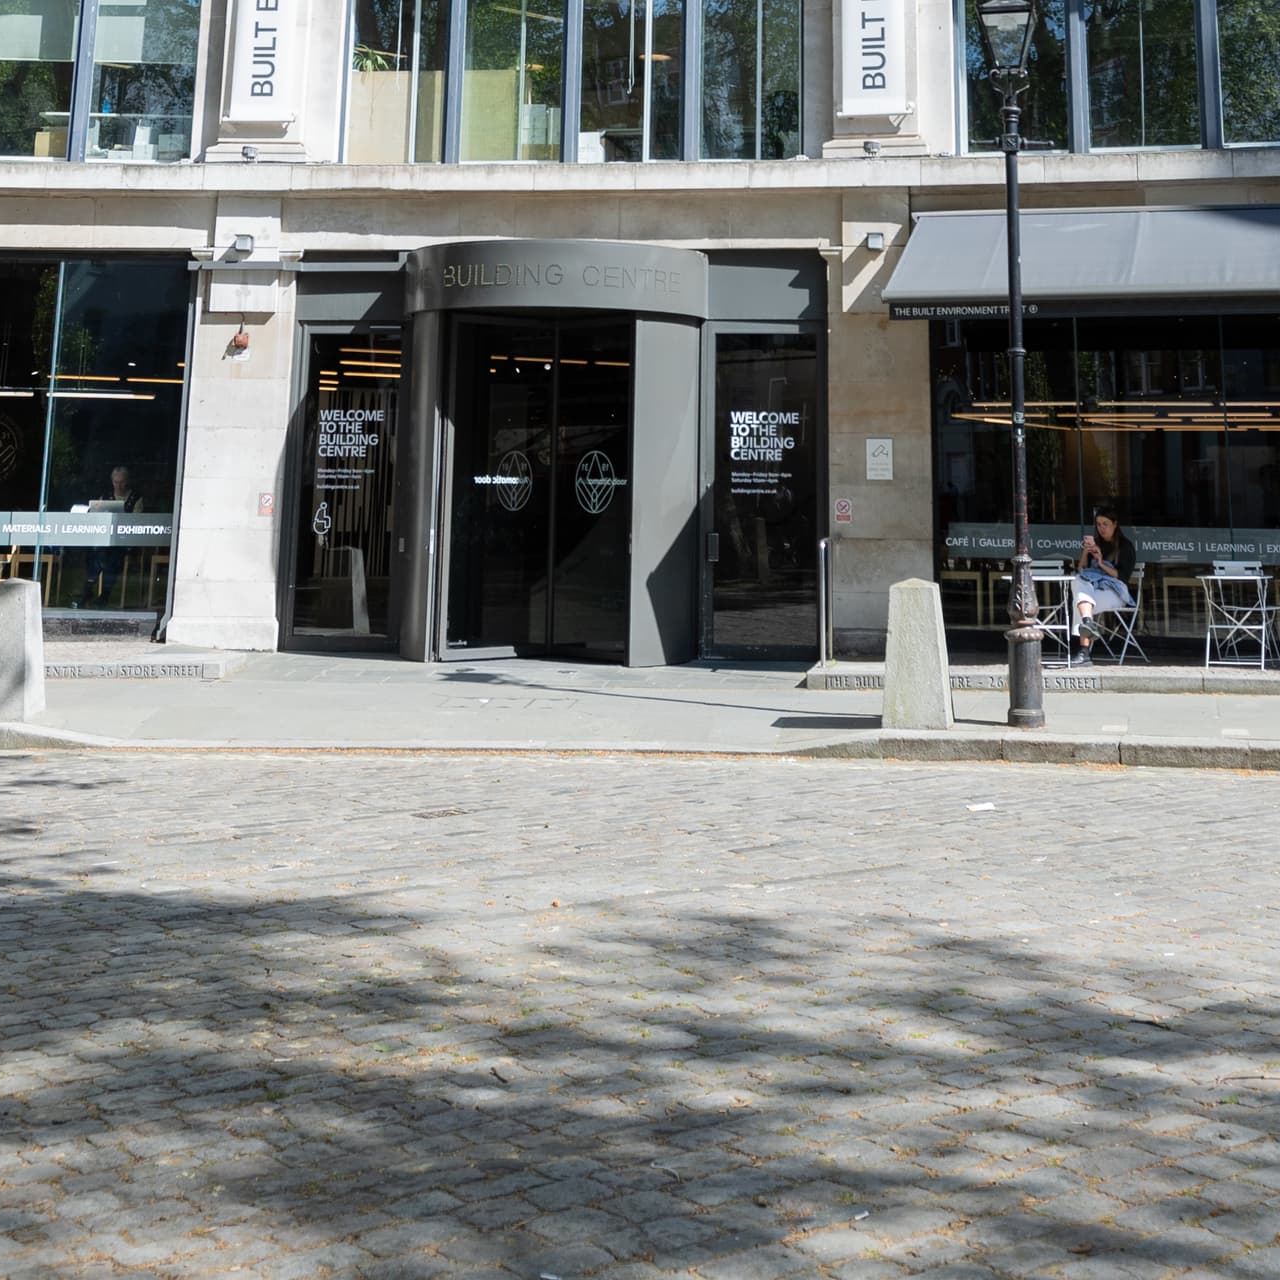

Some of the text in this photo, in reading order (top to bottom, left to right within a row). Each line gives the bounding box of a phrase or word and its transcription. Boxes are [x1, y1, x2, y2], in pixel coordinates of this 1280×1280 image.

[863, 12, 885, 90] BUILT
[250, 21, 277, 97] BUILT
[443, 263, 563, 287] BUILDING
[582, 265, 681, 293] CENTRE
[894, 304, 1026, 317] THE BUILT ENVIRONMENT TRT
[320, 410, 385, 421] WELCOME
[730, 411, 800, 424] WELCOME
[319, 422, 363, 433] TO THE
[730, 424, 777, 436] TO THE
[319, 434, 379, 446] BUILDING
[731, 436, 795, 449] BUILDING
[318, 445, 366, 457] CENTRE
[730, 448, 783, 461] CENTRE
[2, 524, 51, 533] MATERIALS
[62, 525, 107, 535] LEARNING
[117, 526, 172, 536] EXHIBITIONS
[945, 535, 969, 547] CAFÉ
[1037, 539, 1084, 549] CO-WORK
[1142, 541, 1194, 552] MATERIALS
[1205, 543, 1255, 553] LEARNING
[45, 665, 83, 677] ENTRE
[100, 666, 113, 677] 26
[120, 665, 157, 677] STORE
[160, 665, 199, 677] STREET
[828, 675, 849, 687] THE
[990, 676, 1004, 688] 26
[1055, 677, 1097, 689] STREET
